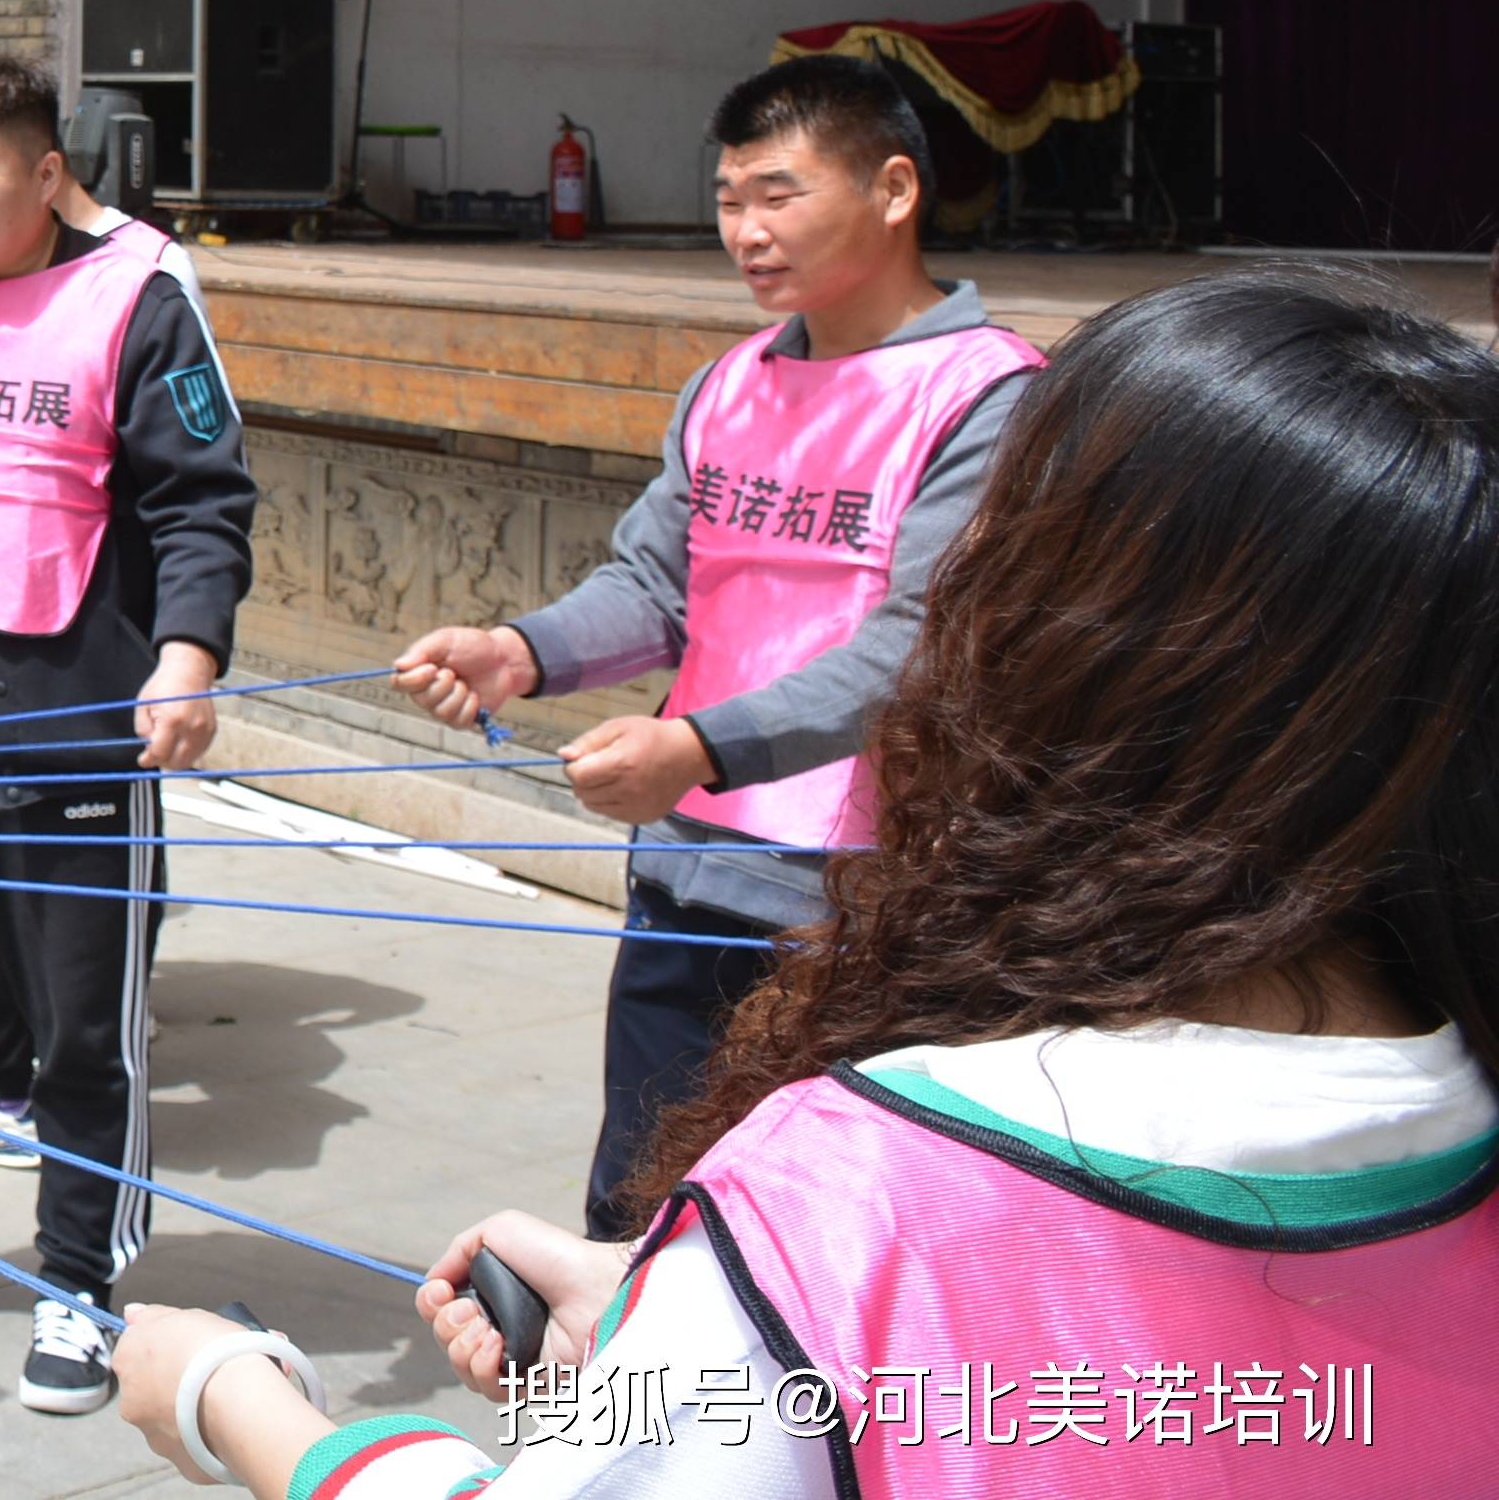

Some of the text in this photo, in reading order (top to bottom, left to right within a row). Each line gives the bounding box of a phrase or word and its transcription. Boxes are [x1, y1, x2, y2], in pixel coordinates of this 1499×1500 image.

[690, 463, 874, 553] 美诺拓展
[64, 802, 116, 819] adidas
